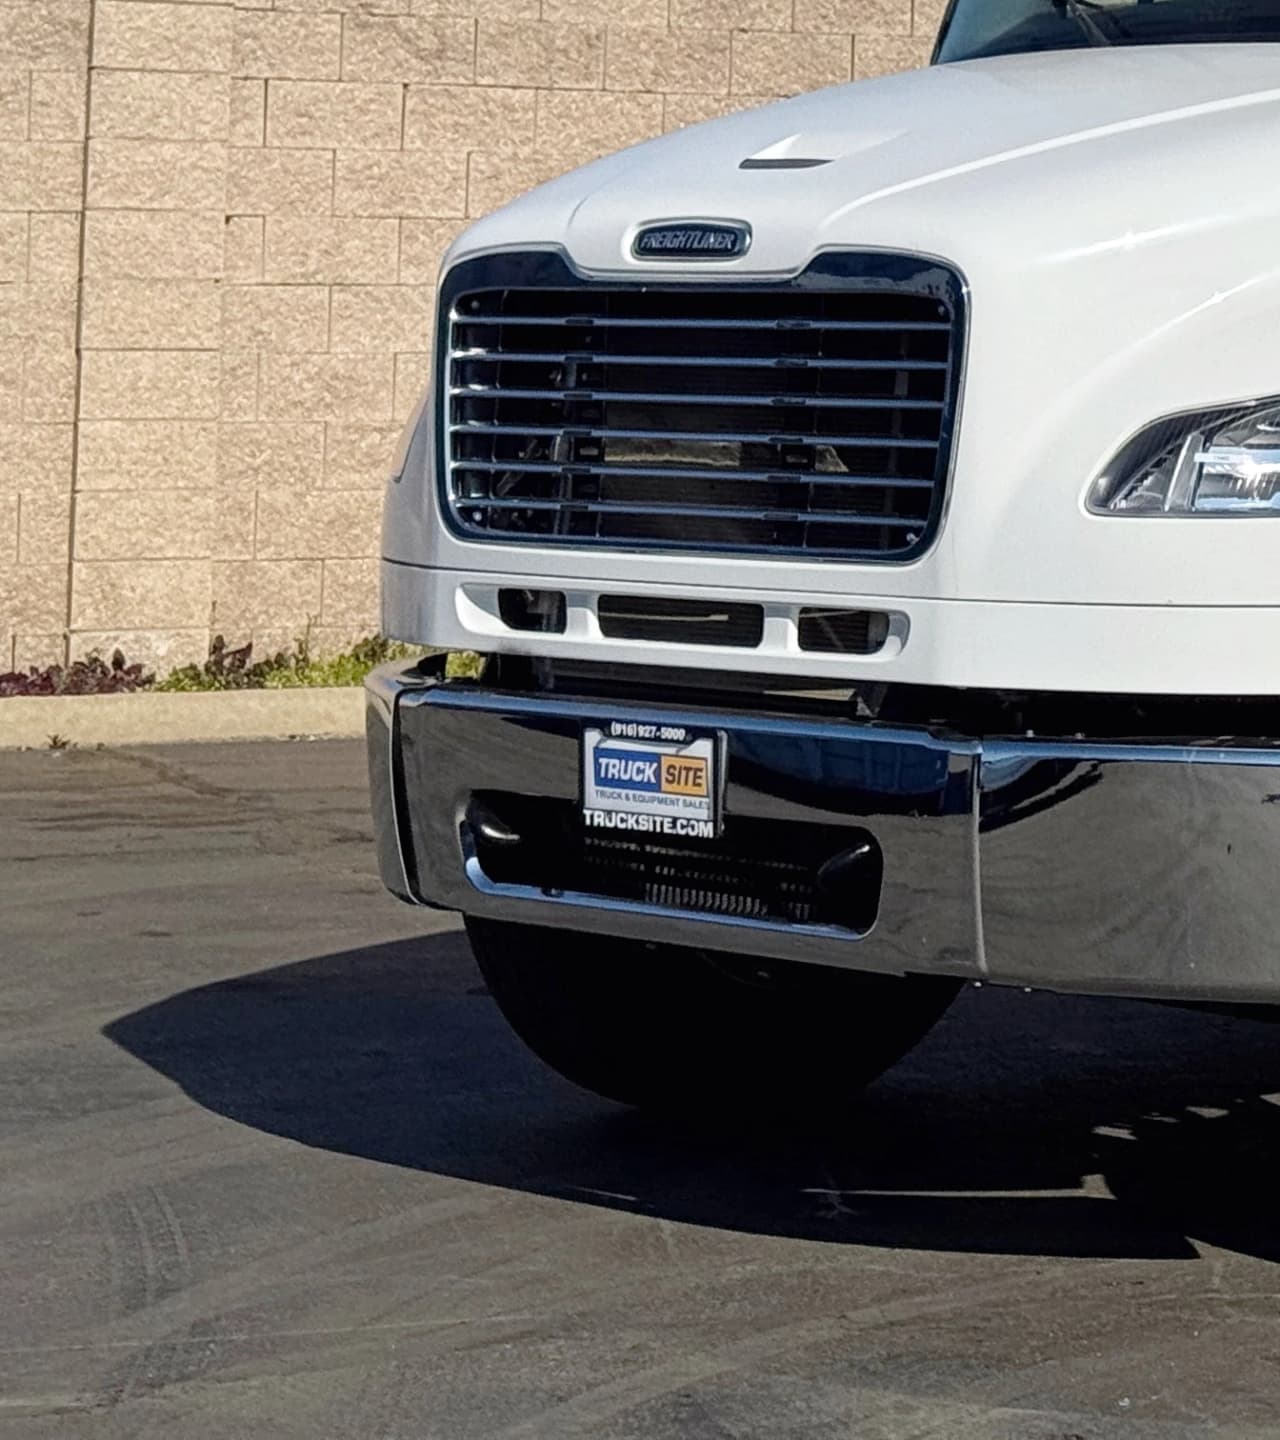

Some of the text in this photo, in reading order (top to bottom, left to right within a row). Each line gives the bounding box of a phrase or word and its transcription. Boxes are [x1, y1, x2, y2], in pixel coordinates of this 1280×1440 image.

[640, 230, 734, 249] FREIGHTLINER
[598, 758, 704, 787] TRUCK SITE
[595, 789, 622, 801] TRUCK
[624, 792, 631, 802] &
[632, 793, 680, 807] EQUIPMENT
[583, 810, 714, 839] TRUCKSITE.COM
